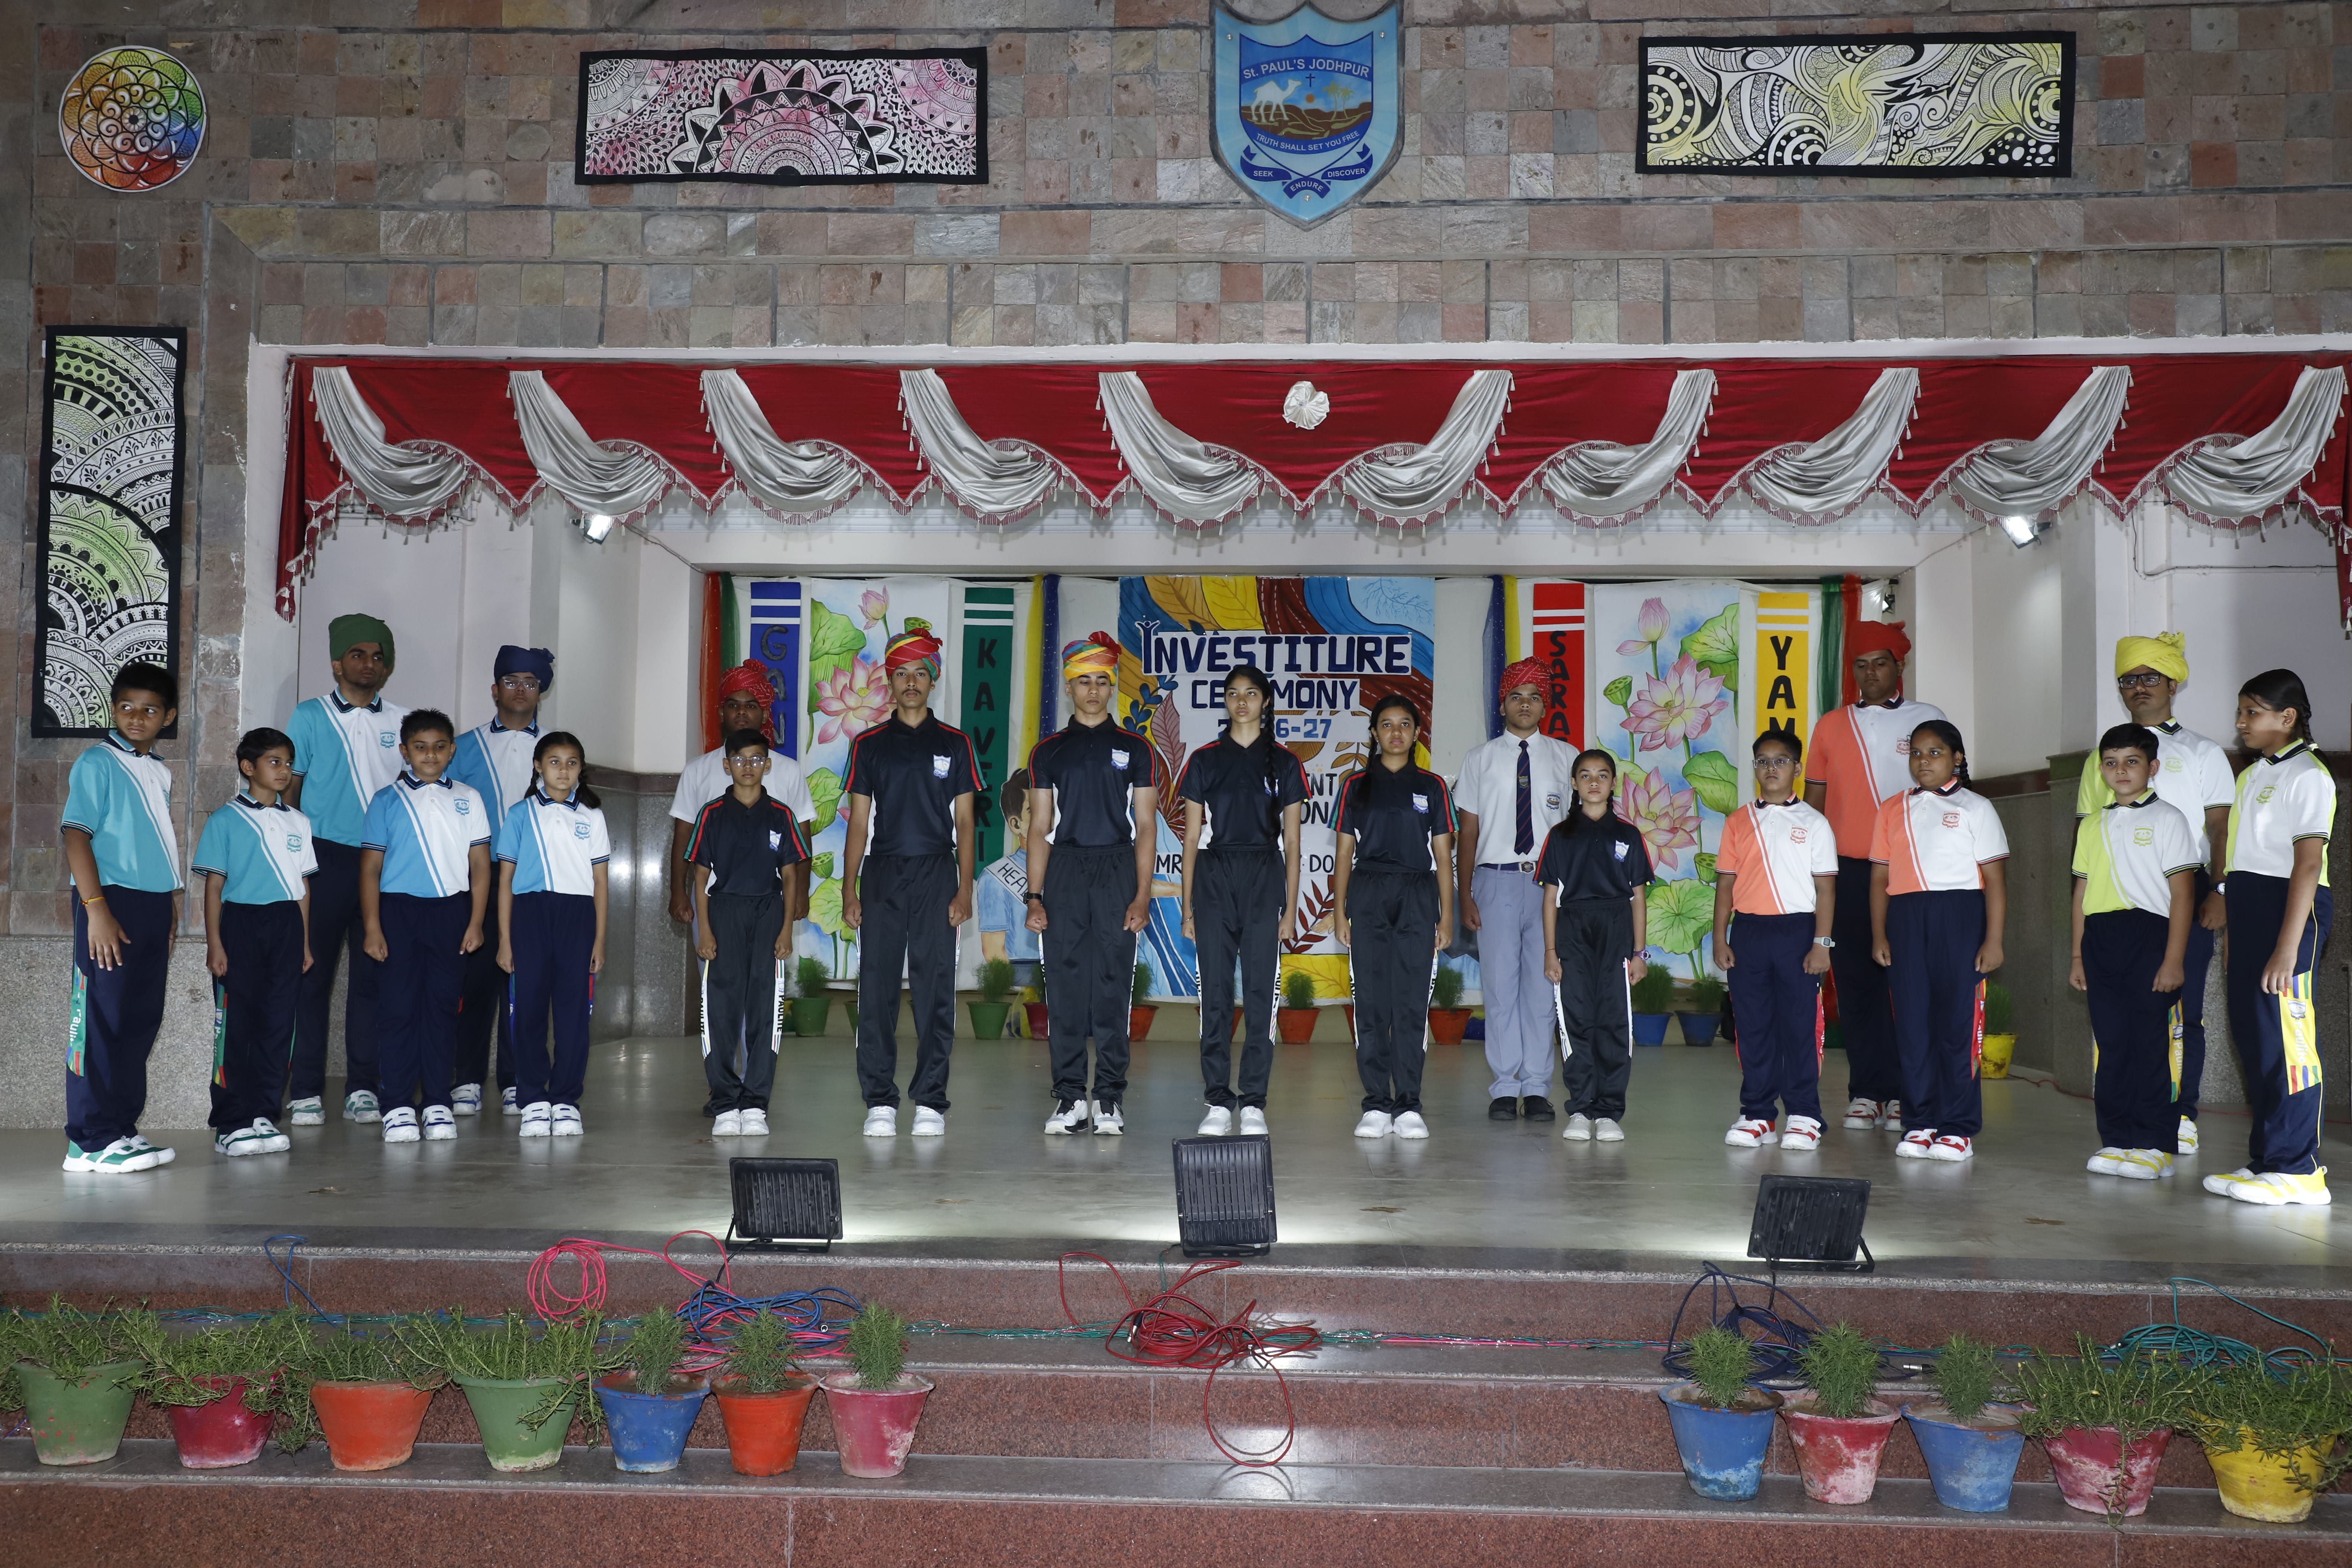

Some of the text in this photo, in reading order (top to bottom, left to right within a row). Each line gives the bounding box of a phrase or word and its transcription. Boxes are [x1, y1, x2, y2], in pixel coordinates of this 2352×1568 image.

[1243, 59, 1369, 78] St. PAUL'S JODHPUR
[1257, 133, 1279, 147] TRUTH
[1280, 142, 1306, 151] SHALL
[1325, 138, 1341, 148] YOU
[1342, 130, 1360, 142] FREE
[1328, 168, 1366, 178] DISCOVER
[1290, 181, 1323, 192] ENDURE
[1135, 620, 1410, 674] INVESTITURE
[1192, 679, 1357, 709] CEMONY
[1548, 630, 1571, 742] SARA
[1218, 718, 1332, 738] 26-27
